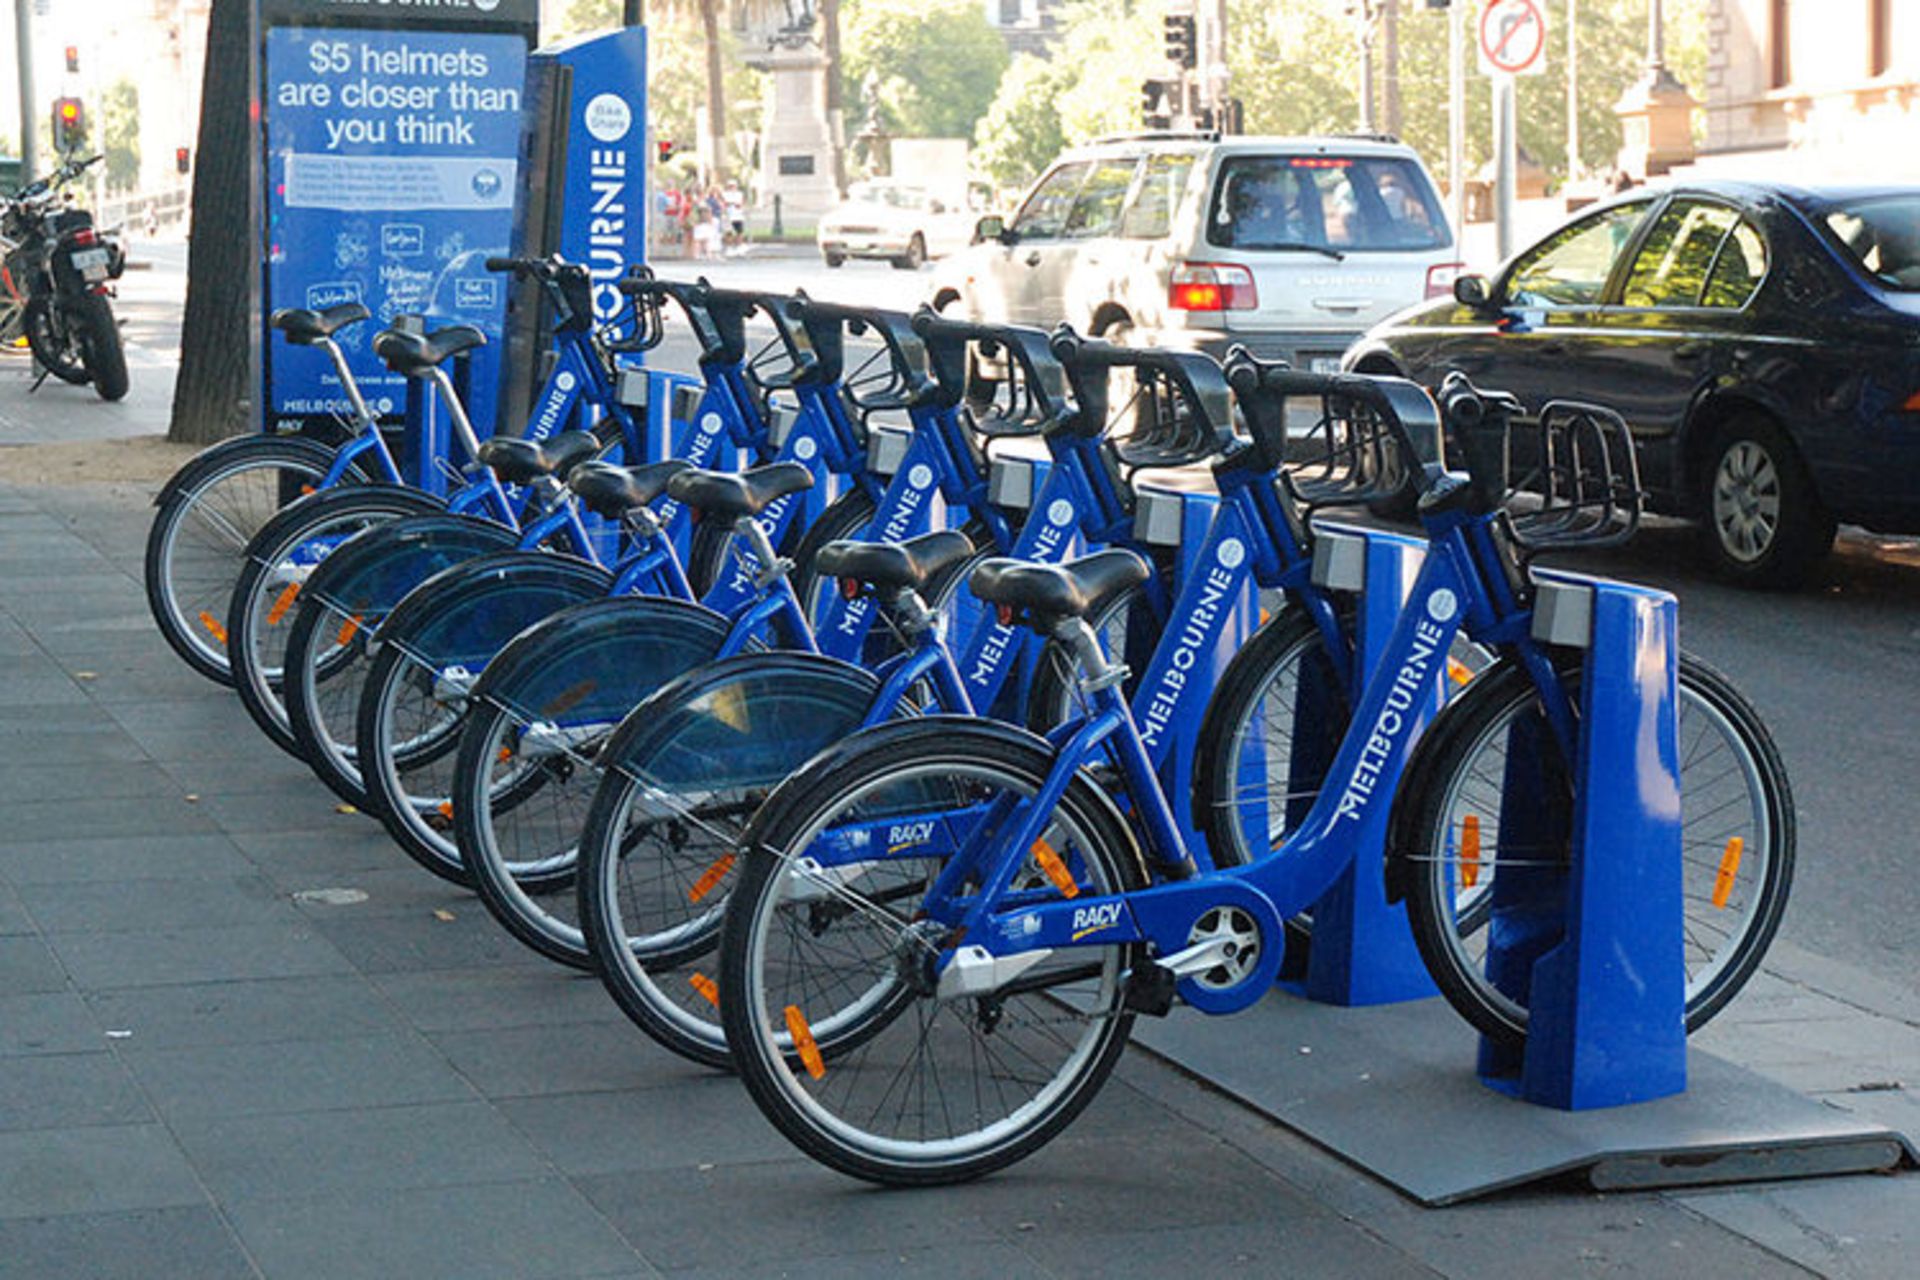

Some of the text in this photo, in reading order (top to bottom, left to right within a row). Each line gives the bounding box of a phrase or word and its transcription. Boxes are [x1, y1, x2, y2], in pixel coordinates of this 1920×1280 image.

[308, 40, 489, 77] $5 helmets
[278, 78, 519, 112] are closer than
[326, 114, 475, 149] you think
[589, 150, 625, 346] OURNE
[1140, 568, 1232, 746] MELBOURNE
[1339, 621, 1443, 821] MELBOURNE
[888, 821, 935, 843] RACV
[1072, 903, 1122, 930] RACV
